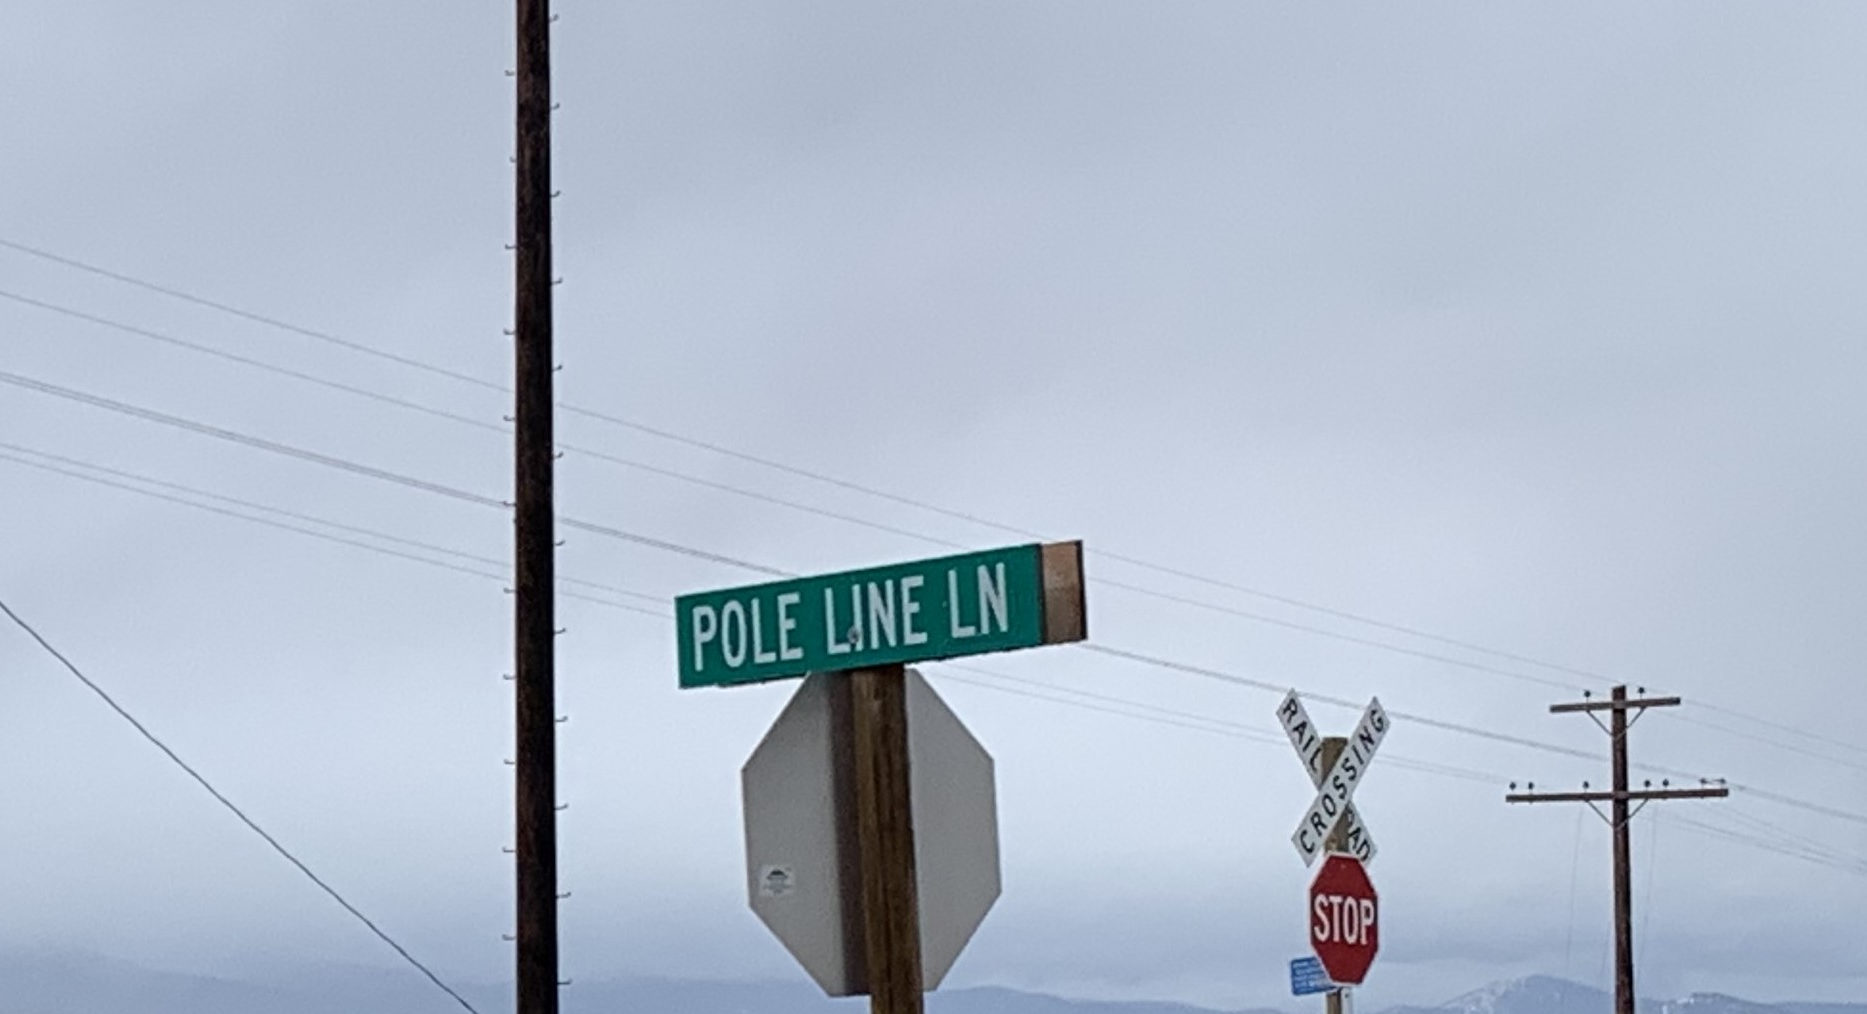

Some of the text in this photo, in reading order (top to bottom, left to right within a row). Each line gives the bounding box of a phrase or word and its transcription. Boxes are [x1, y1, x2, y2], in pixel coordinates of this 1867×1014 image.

[693, 563, 1010, 671] POLE LINE LN
[1283, 699, 1324, 773] RAIL
[1301, 710, 1385, 854] CROSSING
[1314, 895, 1375, 946] STOP
